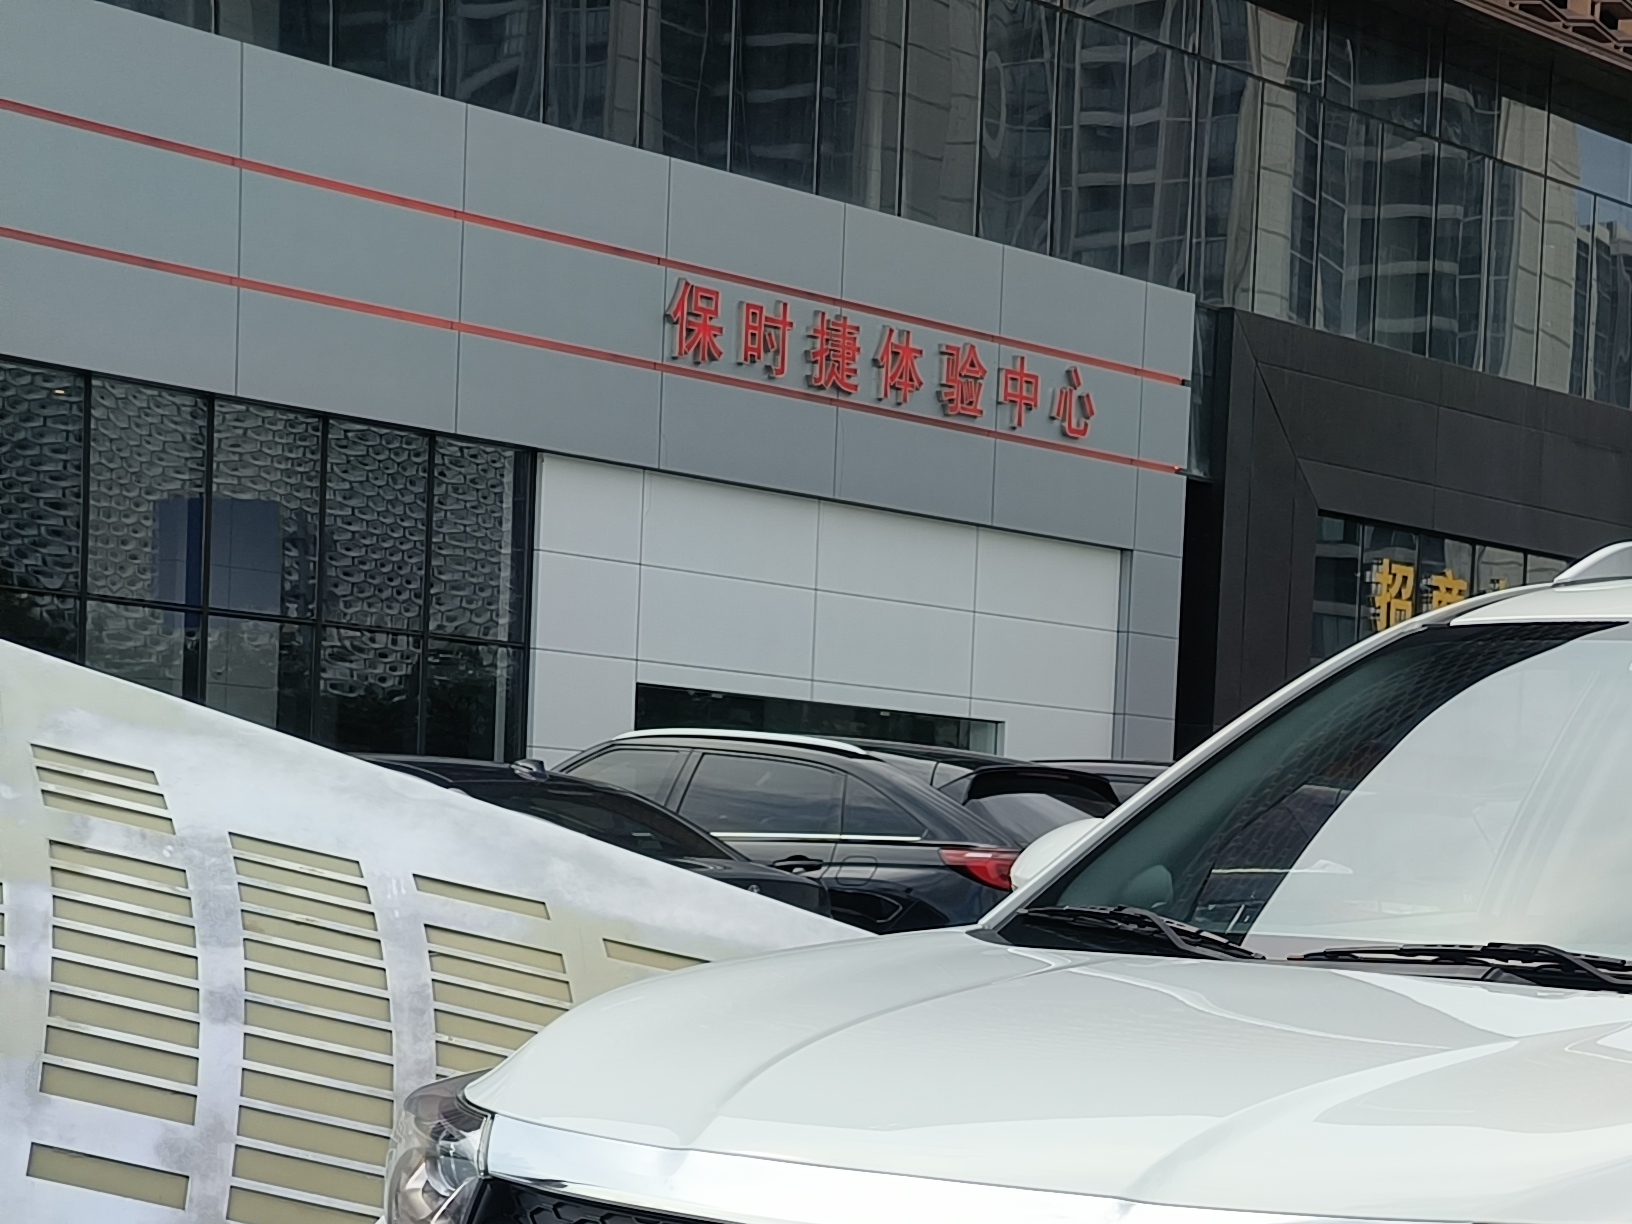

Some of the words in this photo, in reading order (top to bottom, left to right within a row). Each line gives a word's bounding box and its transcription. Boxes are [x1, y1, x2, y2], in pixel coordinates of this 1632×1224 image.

[666, 278, 1095, 439] 保时捷体验中心
